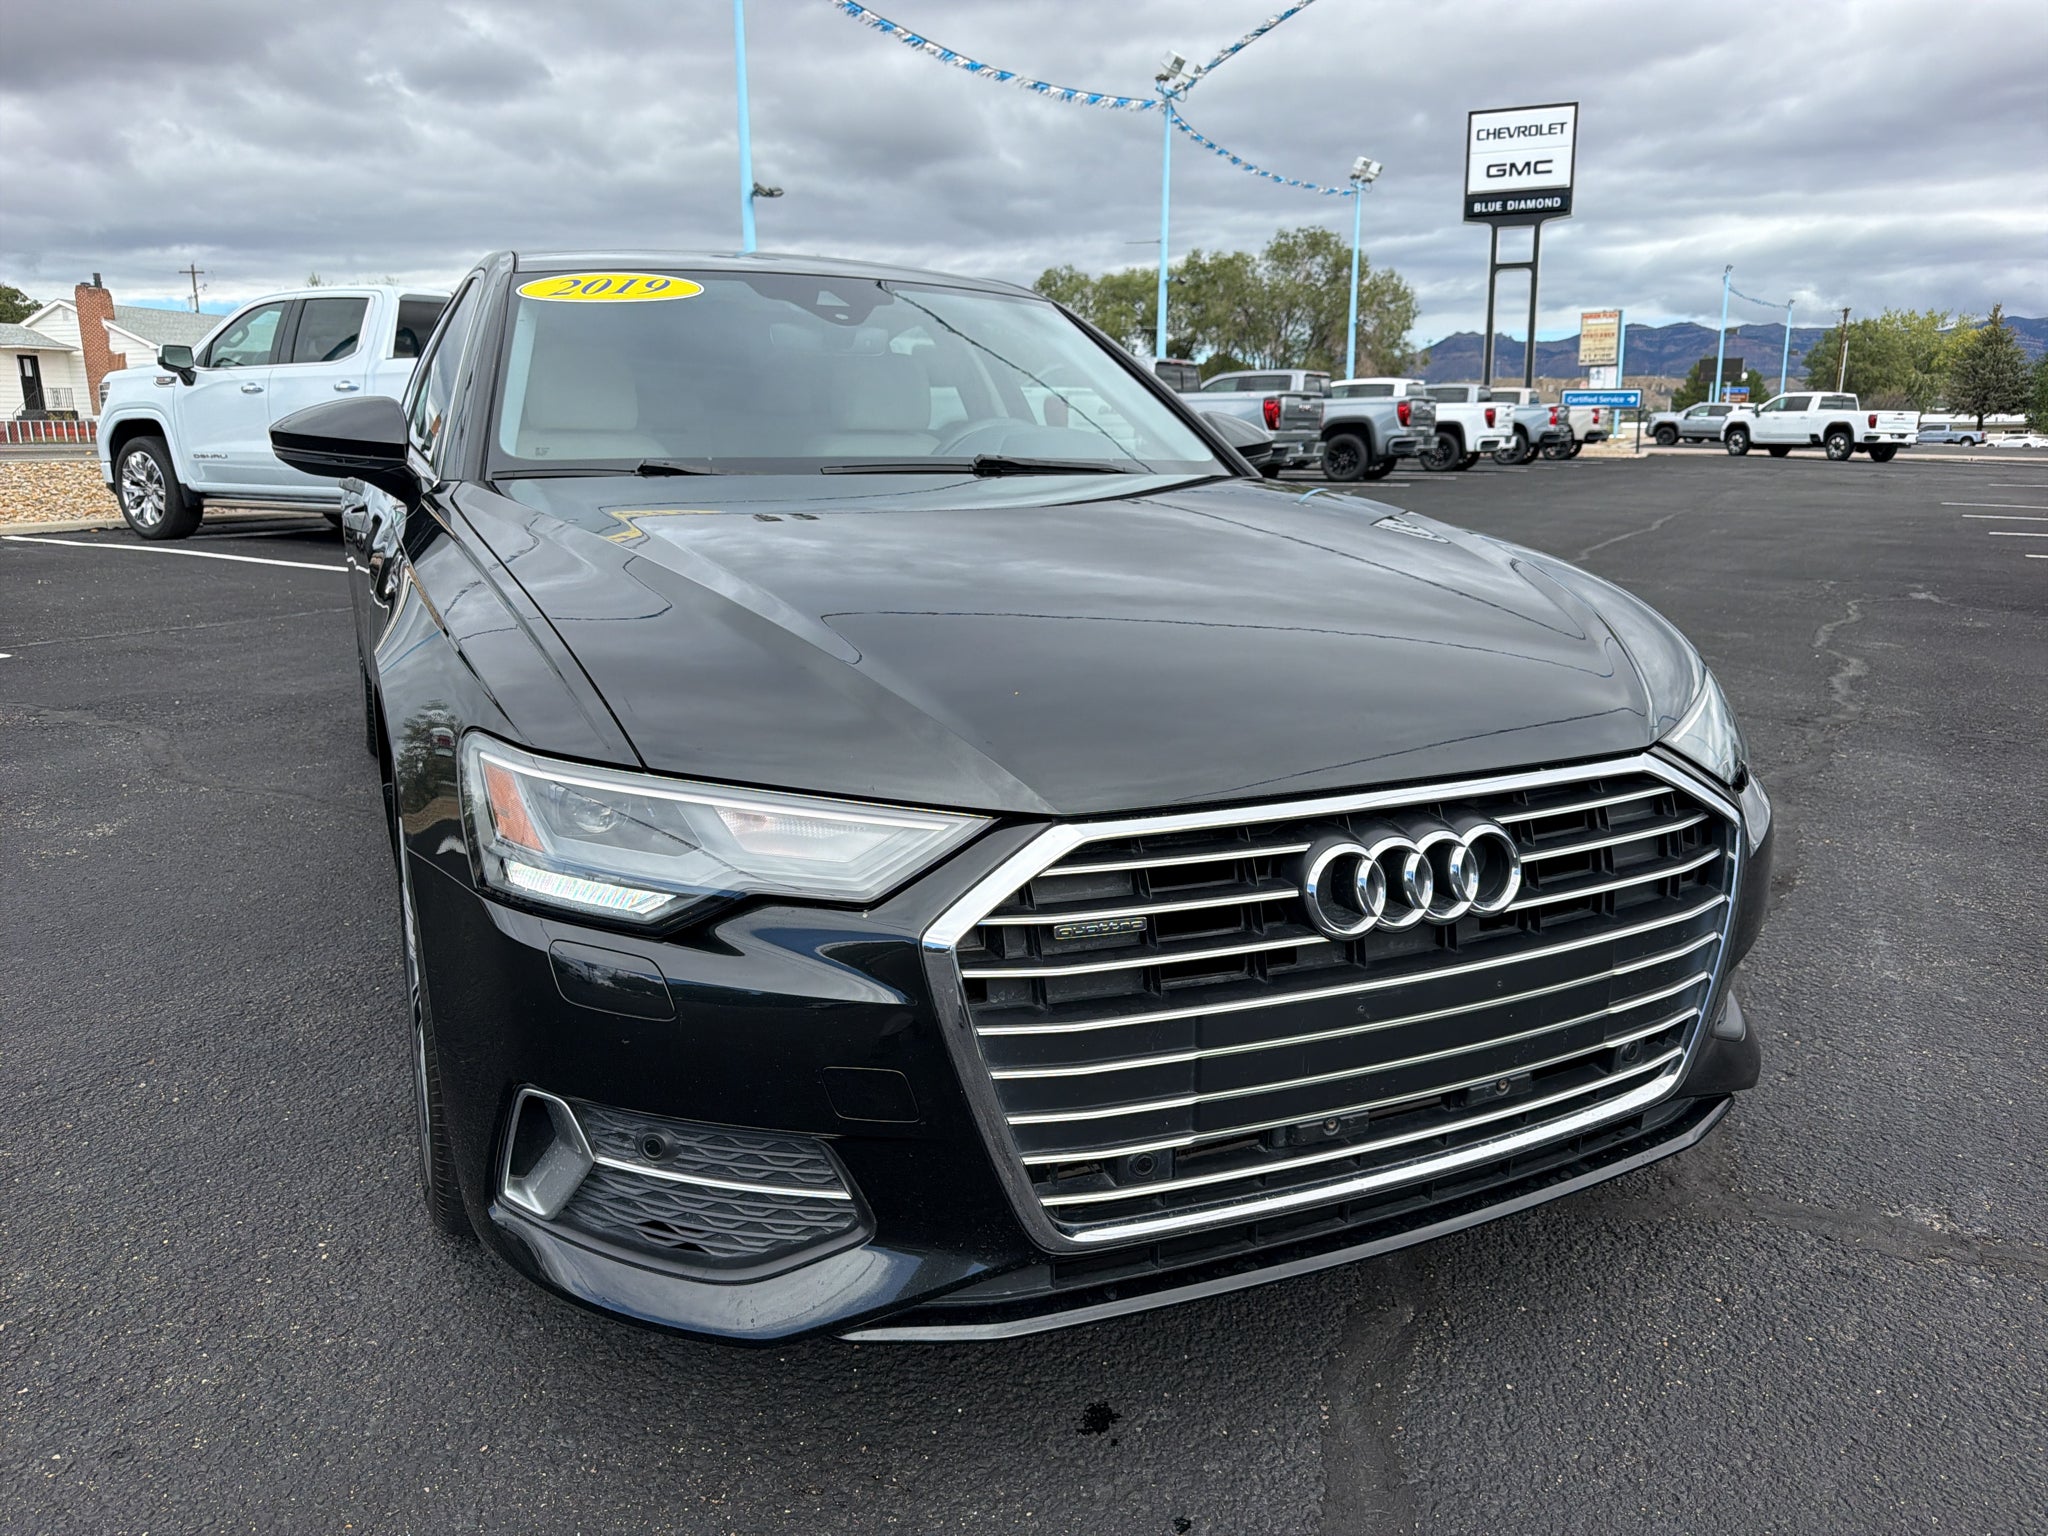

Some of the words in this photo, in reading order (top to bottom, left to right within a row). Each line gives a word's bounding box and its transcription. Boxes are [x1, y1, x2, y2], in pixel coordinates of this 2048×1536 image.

[1476, 122, 1568, 141] CHEVROLET
[1486, 160, 1553, 178] GMC
[1474, 201, 1503, 213] BLUE
[1507, 197, 1561, 211] DIAMOND
[548, 278, 671, 296] 2019
[1567, 395, 1598, 404] Certified
[1599, 395, 1625, 404] Service
[1059, 920, 1143, 937] quattro
